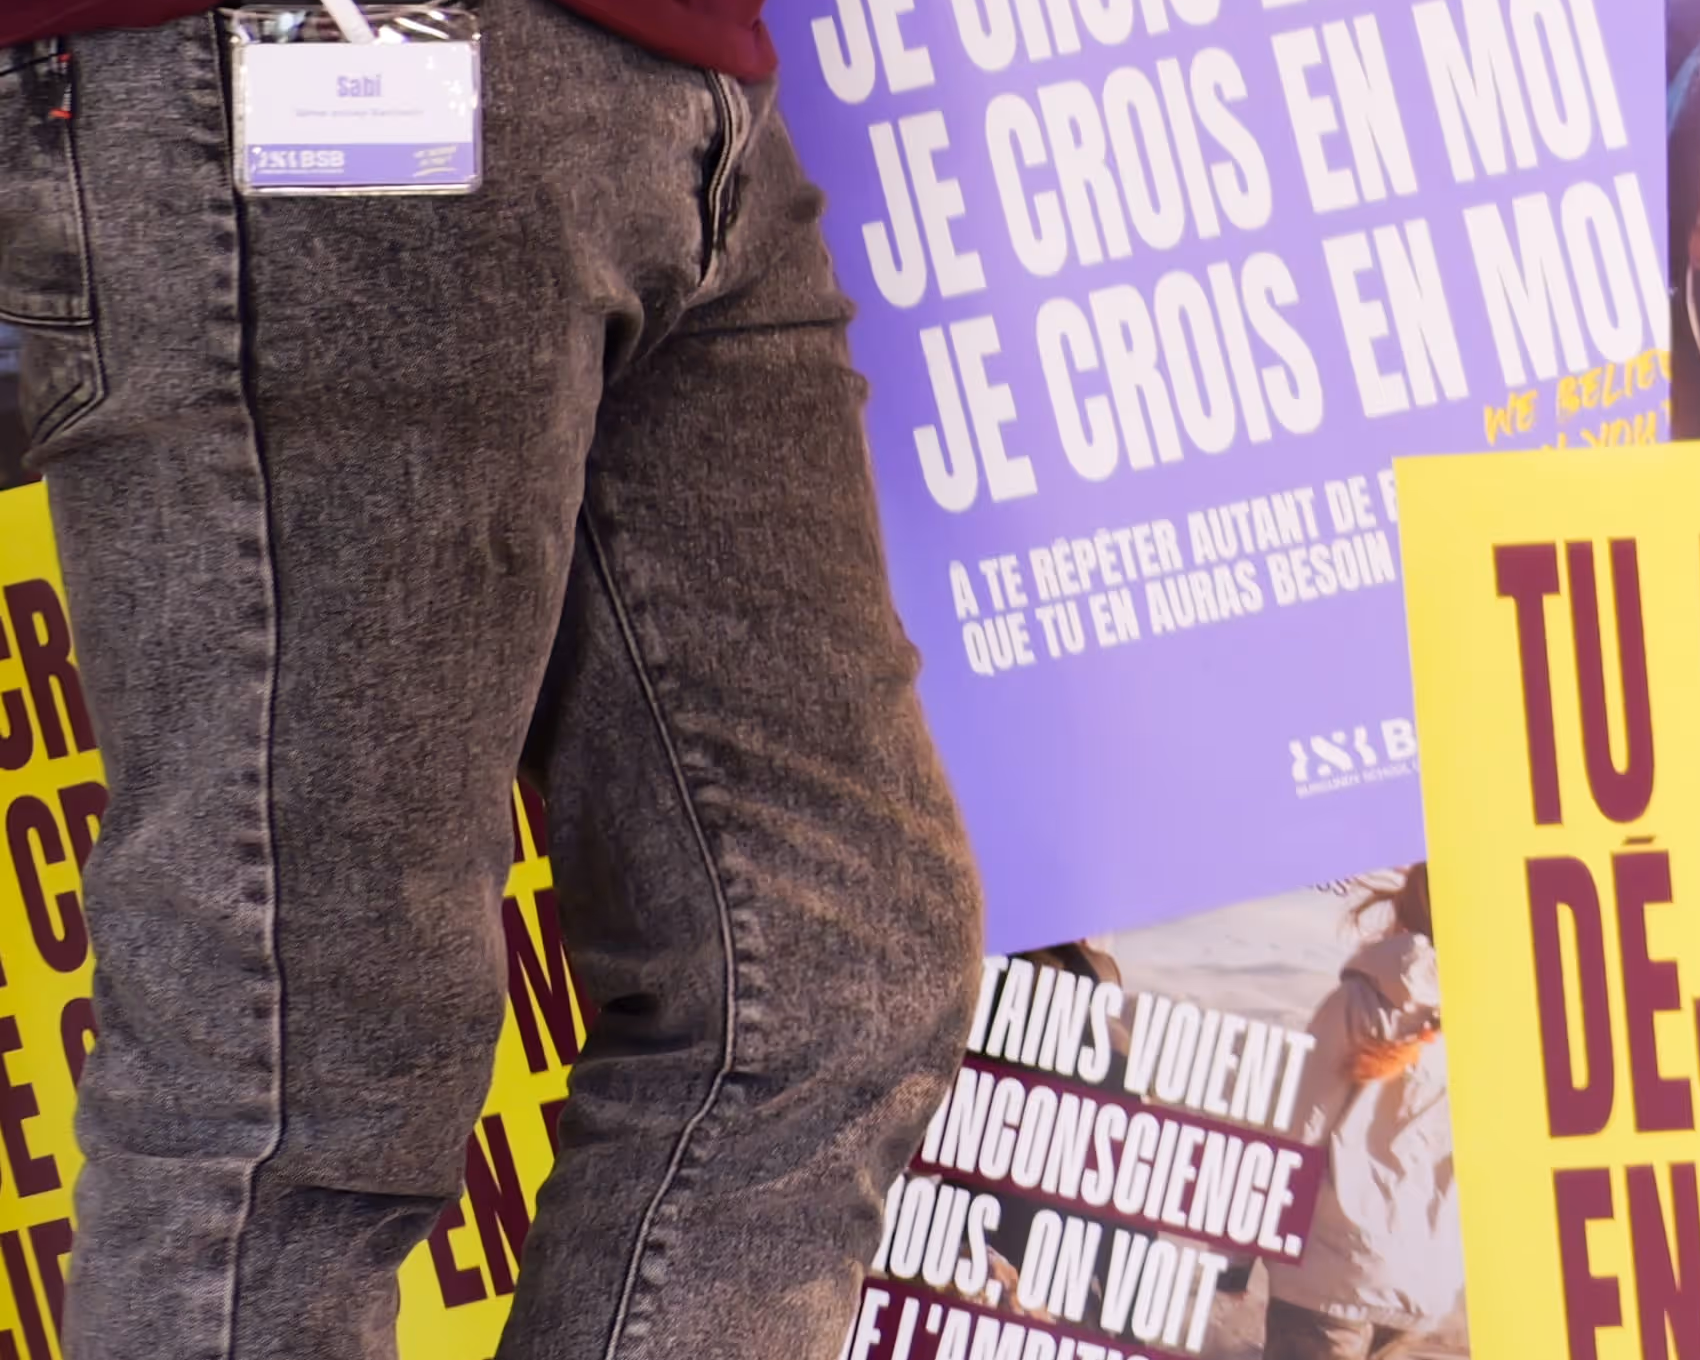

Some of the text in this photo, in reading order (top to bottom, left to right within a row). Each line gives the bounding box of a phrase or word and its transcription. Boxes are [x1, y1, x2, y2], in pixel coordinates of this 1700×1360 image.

[300, 150, 345, 168] BSB
[862, 112, 984, 309] JE
[985, 48, 1273, 277] CROIS
[1272, 14, 1417, 213] EN
[912, 173, 1671, 513] JE CROIS EN MOI
[1484, 389, 1537, 447] WE
[962, 530, 1396, 676] QUE TU EN AURAS BESOIN
[978, 554, 1028, 612] TE
[1187, 487, 1320, 565] AUTANT
[1324, 475, 1377, 534] DE
[1493, 536, 1656, 826] TU
[1125, 991, 1316, 1130] VOIENT
[1018, 1209, 1102, 1322] ON
[1100, 1228, 1228, 1353] VOIT
